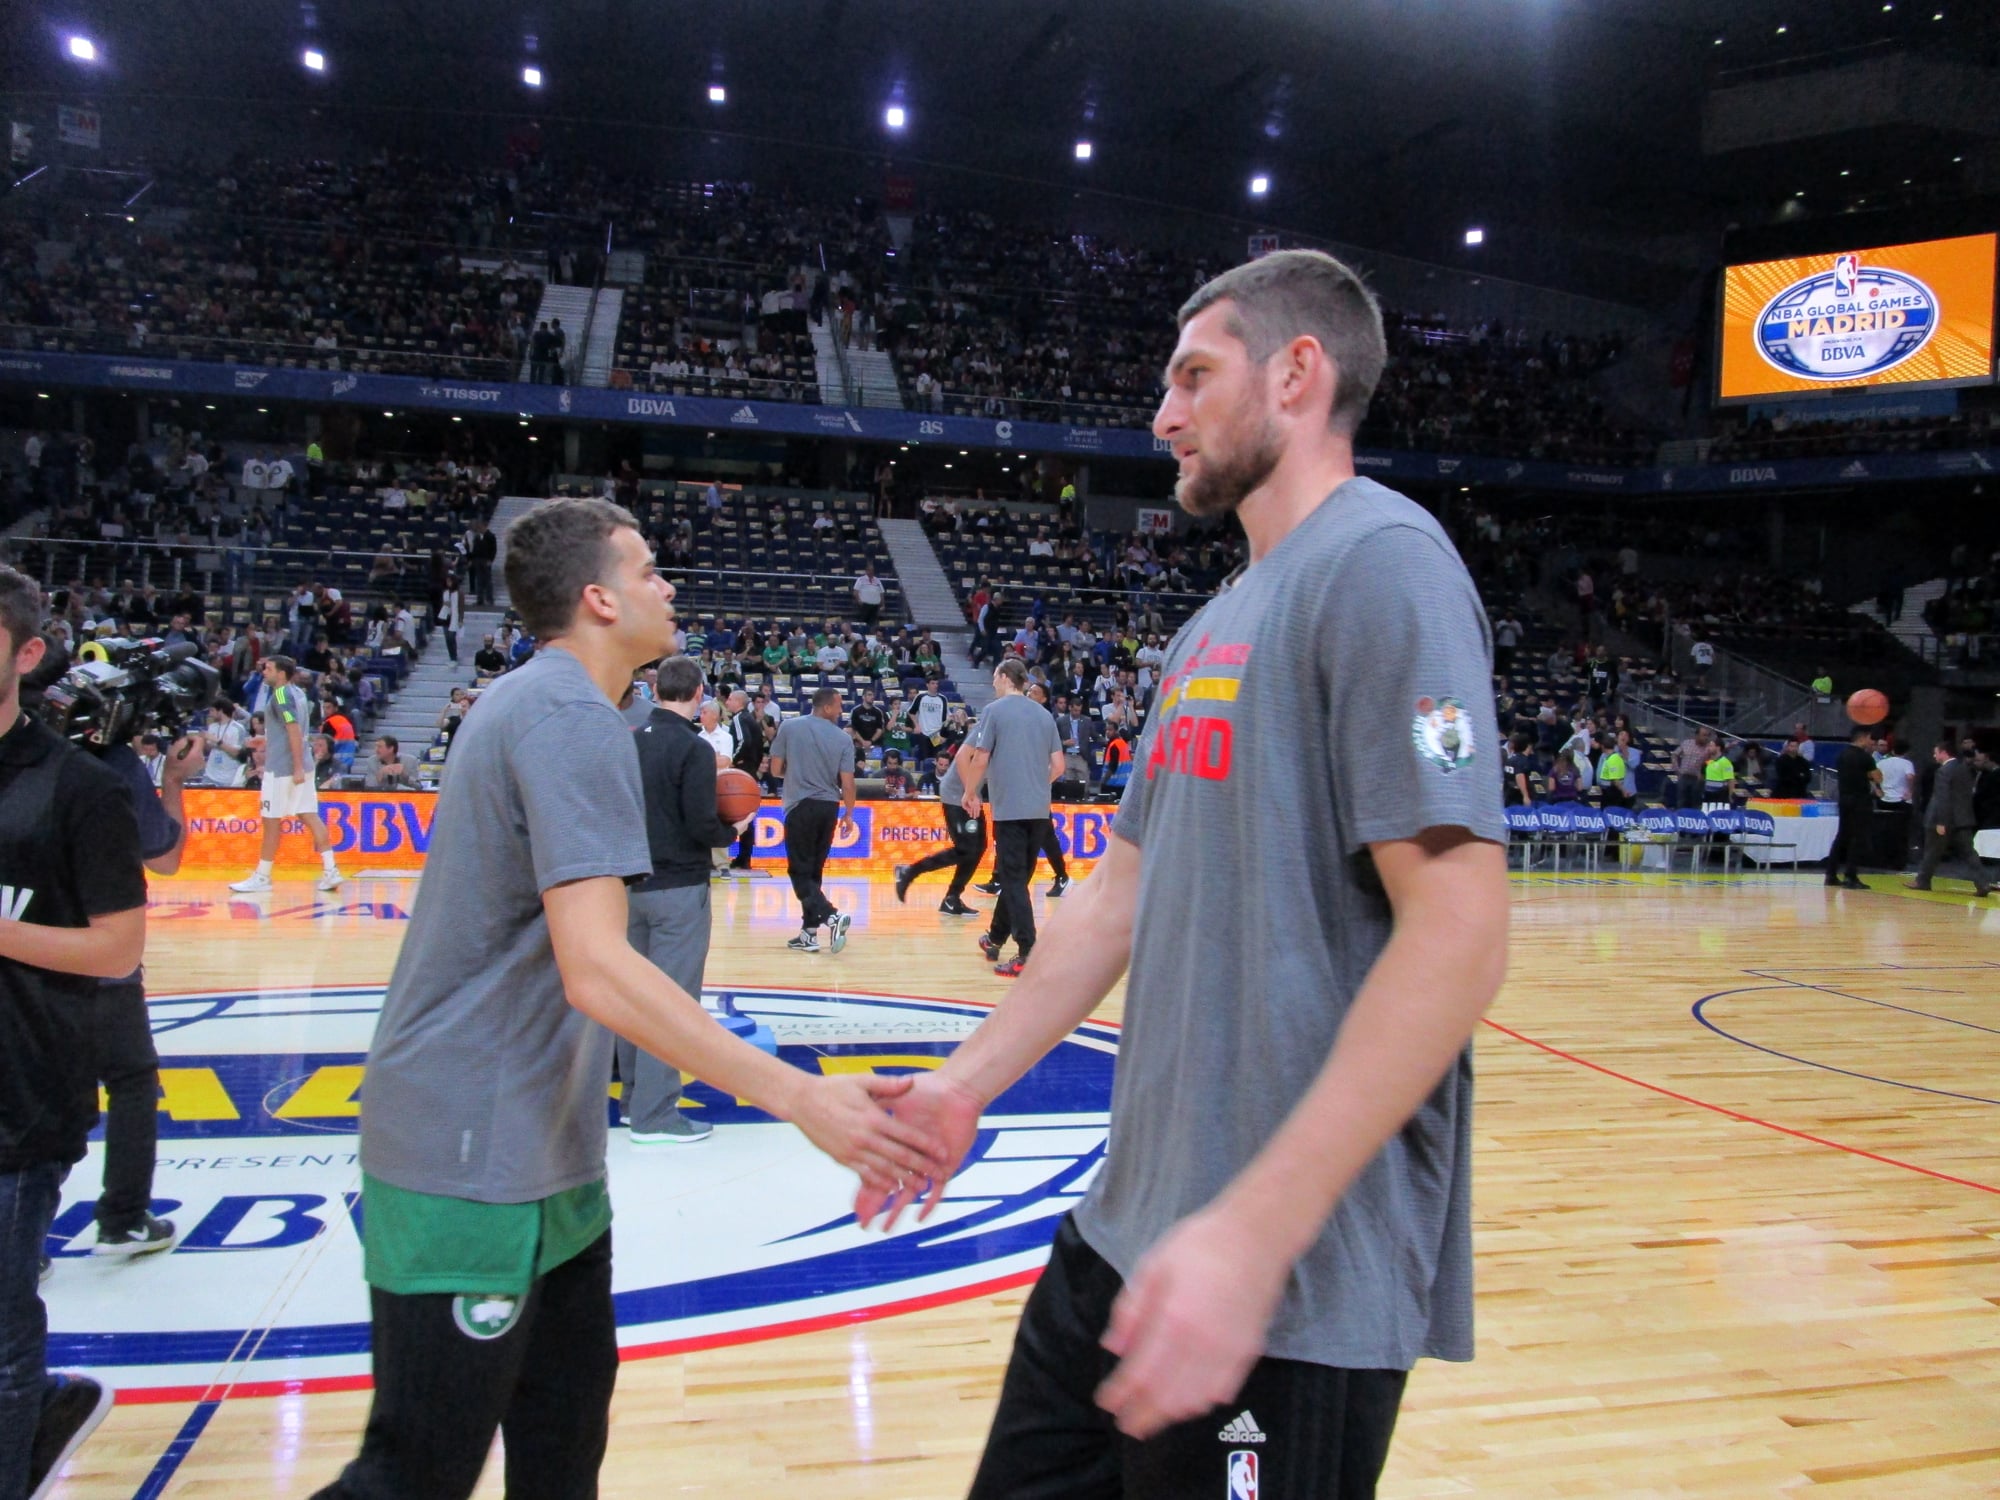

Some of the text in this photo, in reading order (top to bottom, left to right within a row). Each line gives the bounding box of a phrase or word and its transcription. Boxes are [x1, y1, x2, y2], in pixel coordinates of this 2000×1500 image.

[1772, 295, 1922, 321] NBA GLOBAL GAMES
[1788, 310, 1906, 339] MADRID
[1821, 345, 1865, 361] BBVA
[444, 387, 500, 402] TISSOT
[628, 399, 676, 417] BBVA
[919, 420, 944, 434] as
[1730, 467, 1777, 483] BBVA
[317, 802, 437, 853] BBV
[1678, 816, 1709, 830] BBVA
[1744, 816, 1774, 831] BBVA
[777, 1020, 981, 1030] UROLEAGUE
[781, 1027, 974, 1037] ASKETBAL
[1218, 1431, 1267, 1443] adidas
